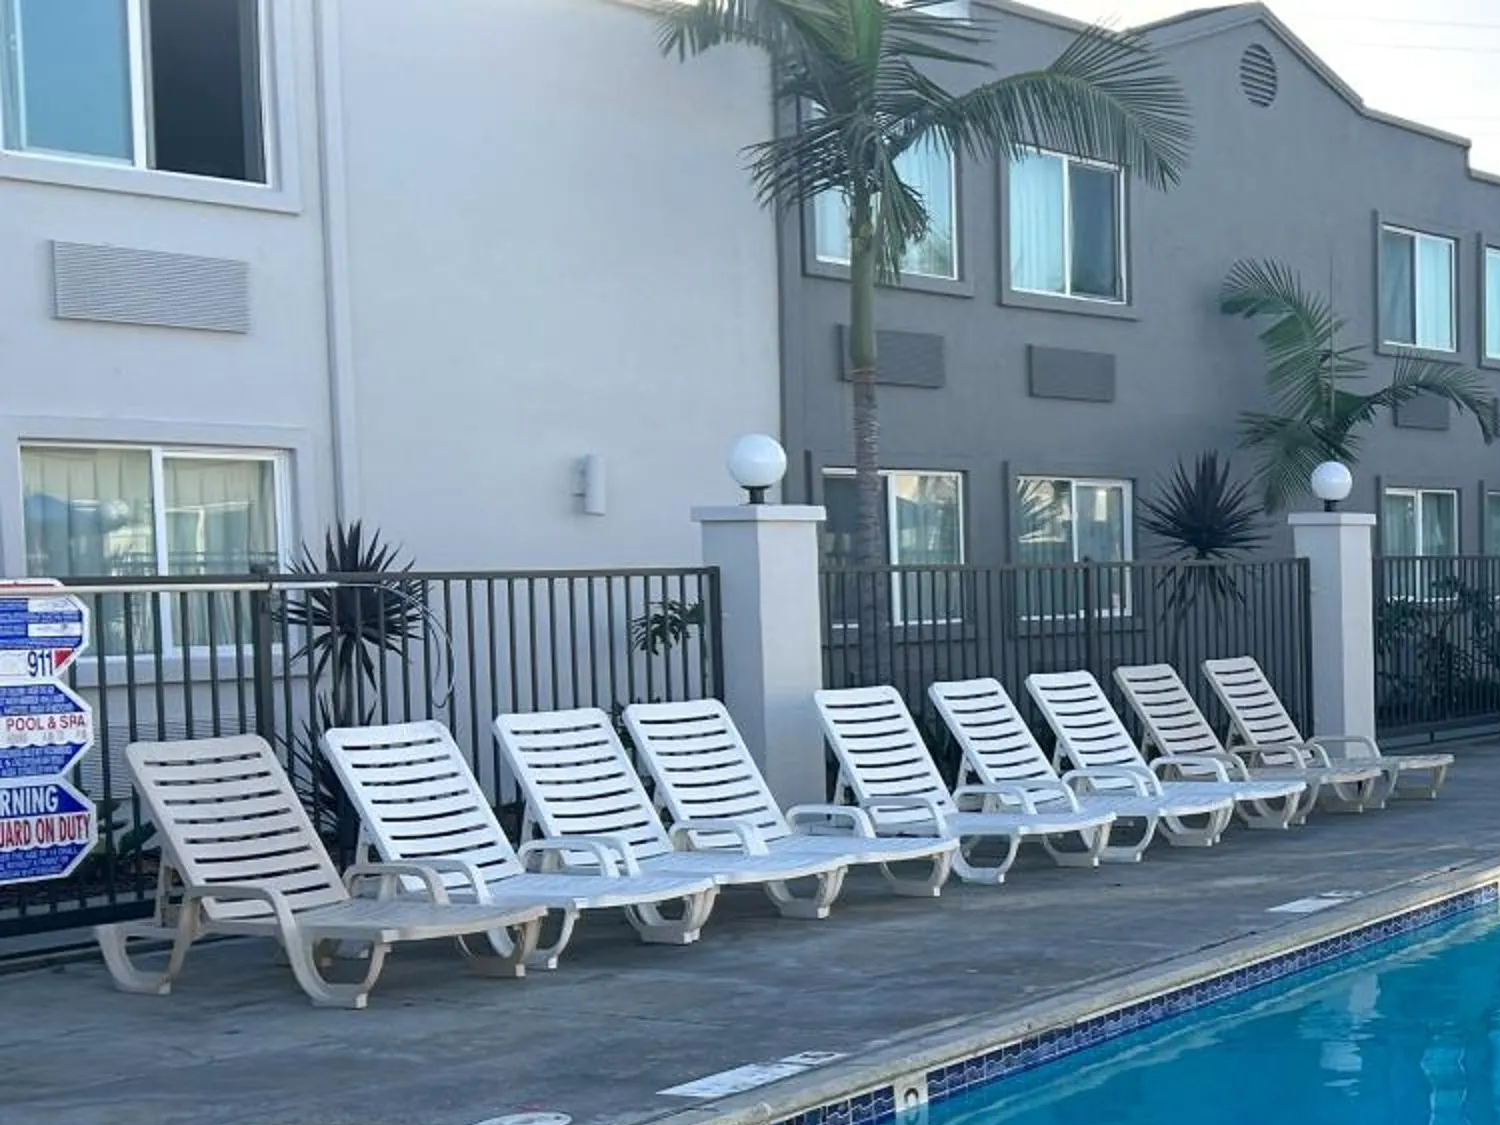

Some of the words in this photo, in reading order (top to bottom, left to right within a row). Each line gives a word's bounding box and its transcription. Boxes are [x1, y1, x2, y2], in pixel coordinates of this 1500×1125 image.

[27, 650, 53, 677] 911
[6, 717, 44, 731] POOL
[47, 715, 57, 729] &
[60, 713, 85, 729] SPA
[36, 817, 55, 844] ON
[60, 812, 90, 842] DUTY
